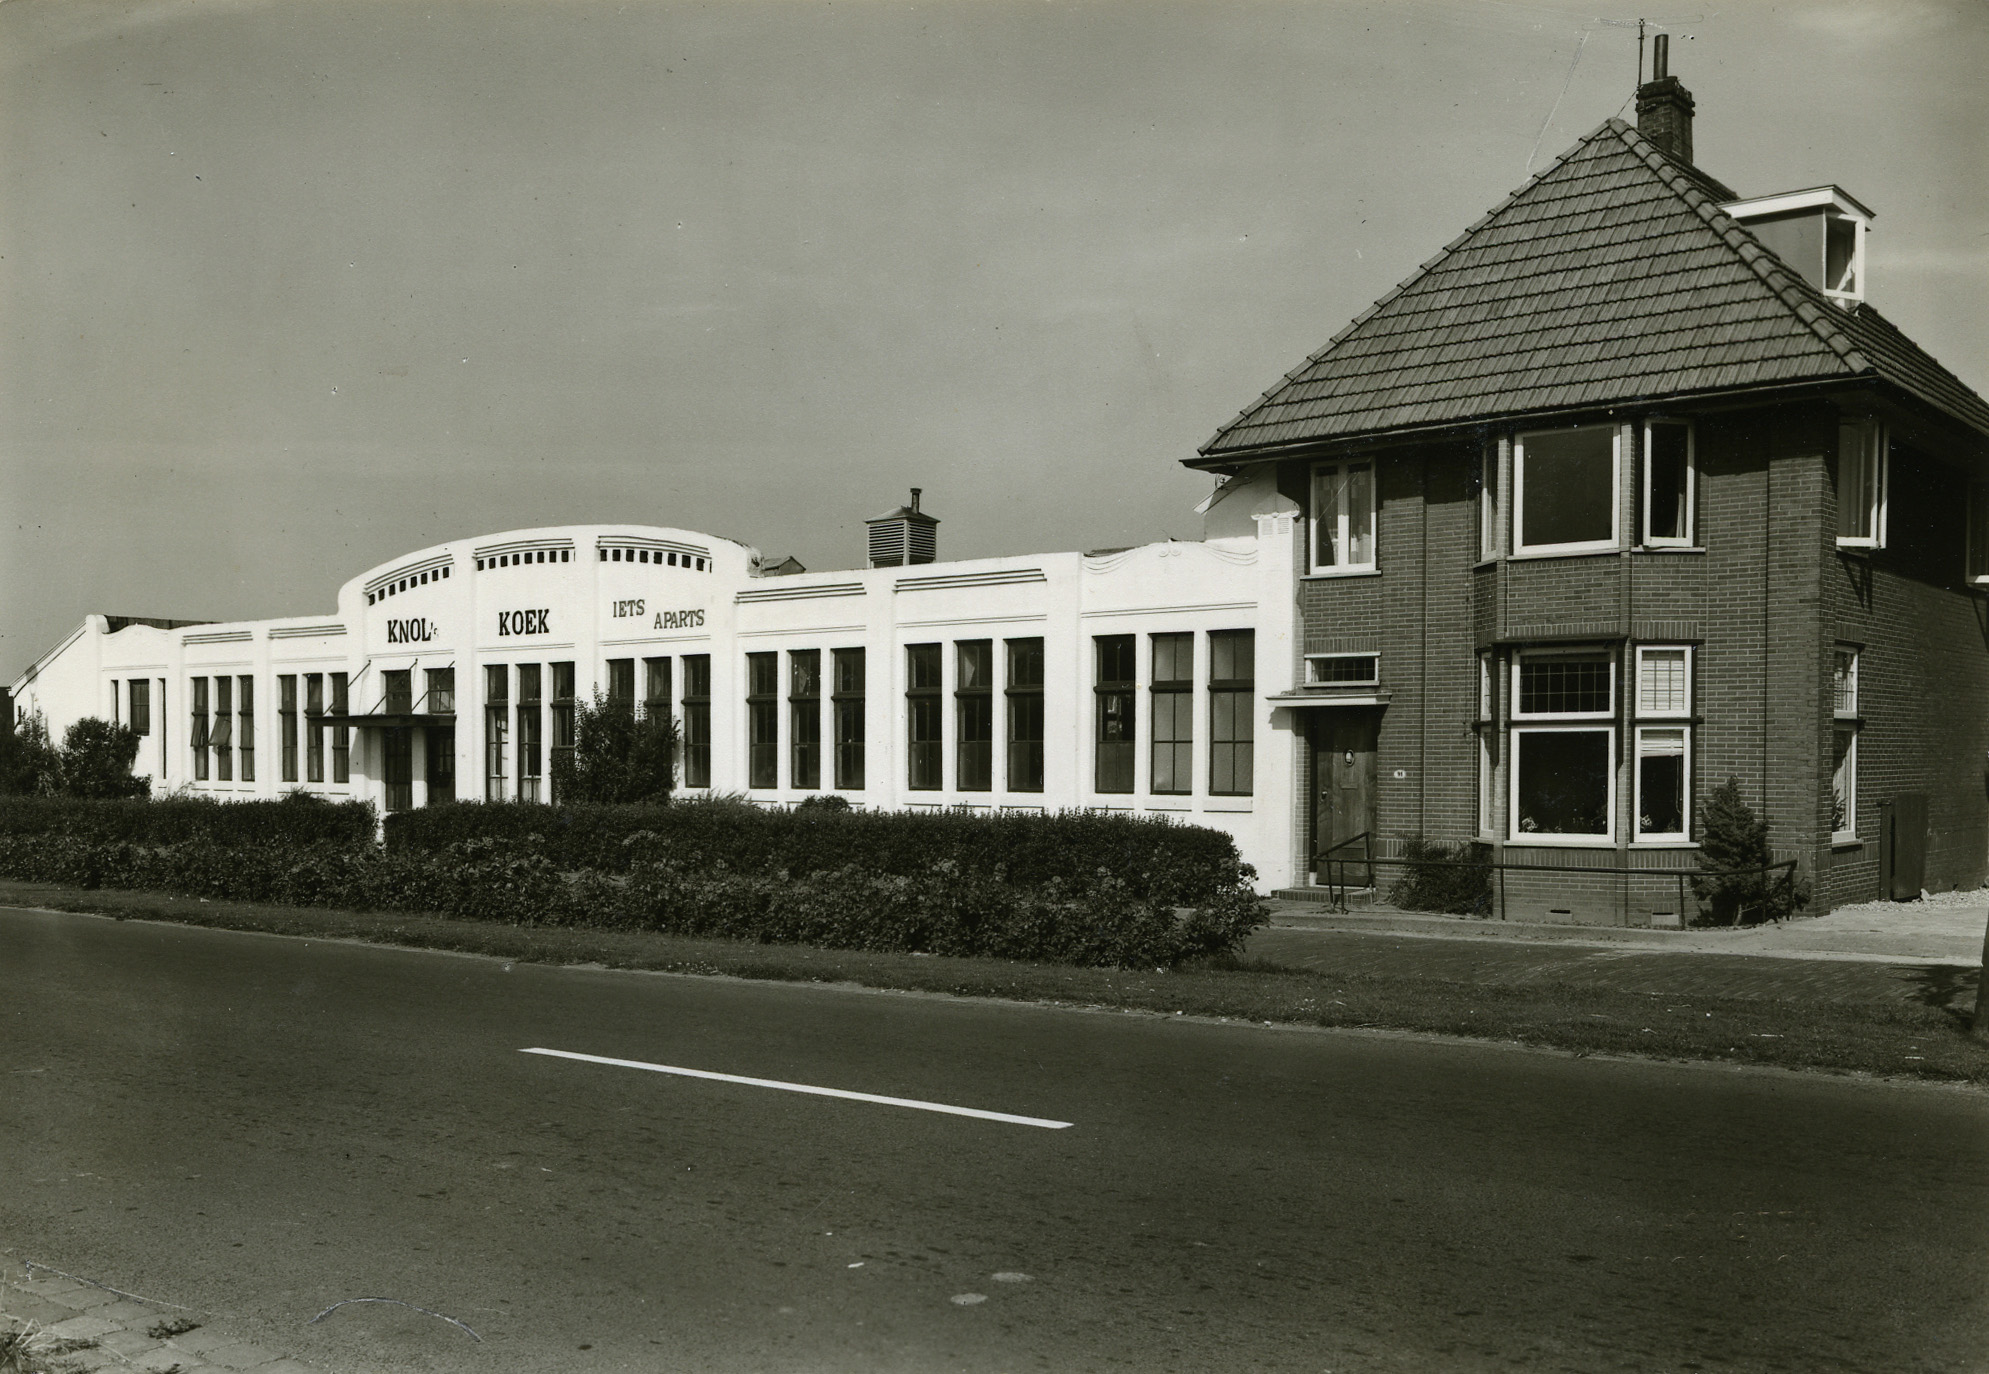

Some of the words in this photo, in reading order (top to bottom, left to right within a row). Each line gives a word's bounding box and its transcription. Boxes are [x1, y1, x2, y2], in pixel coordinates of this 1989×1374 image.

[498, 608, 550, 637] KOEK
[612, 599, 646, 618] IETS
[653, 608, 705, 630] APARTS
